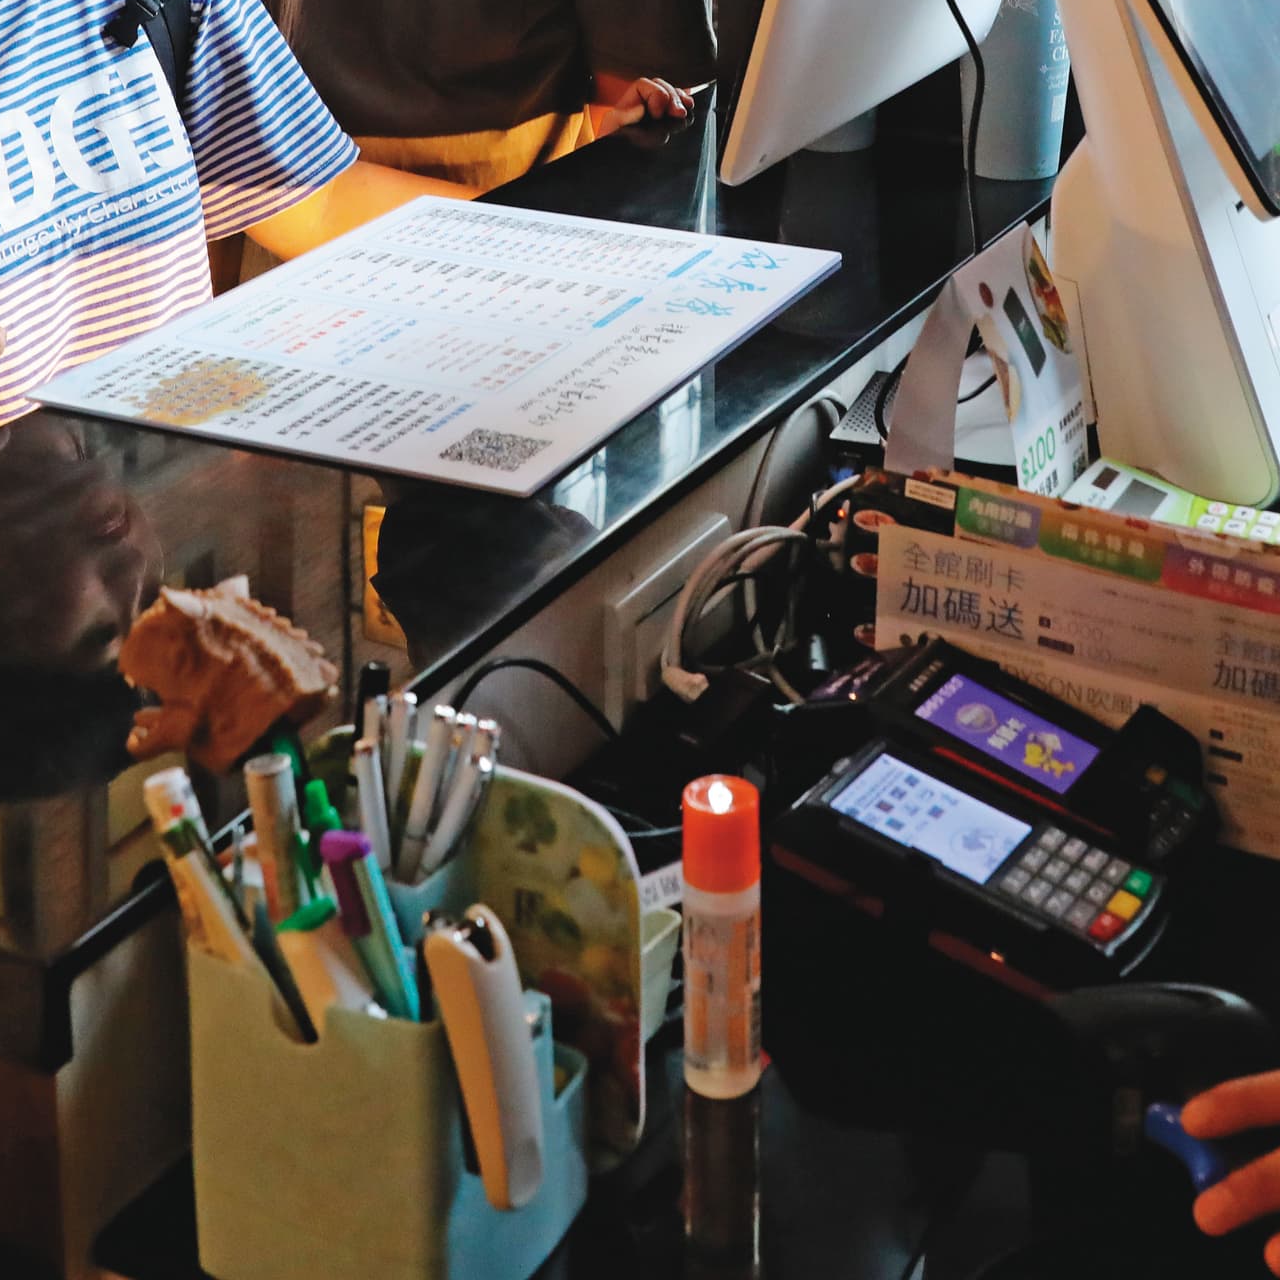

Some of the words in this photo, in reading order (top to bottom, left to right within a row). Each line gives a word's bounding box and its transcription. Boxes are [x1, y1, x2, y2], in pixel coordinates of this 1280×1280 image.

[53, 215, 86, 239] My
[1021, 426, 1056, 487] $100
[903, 541, 1026, 593] 全館刷卡
[900, 576, 1025, 641] 加碼送
